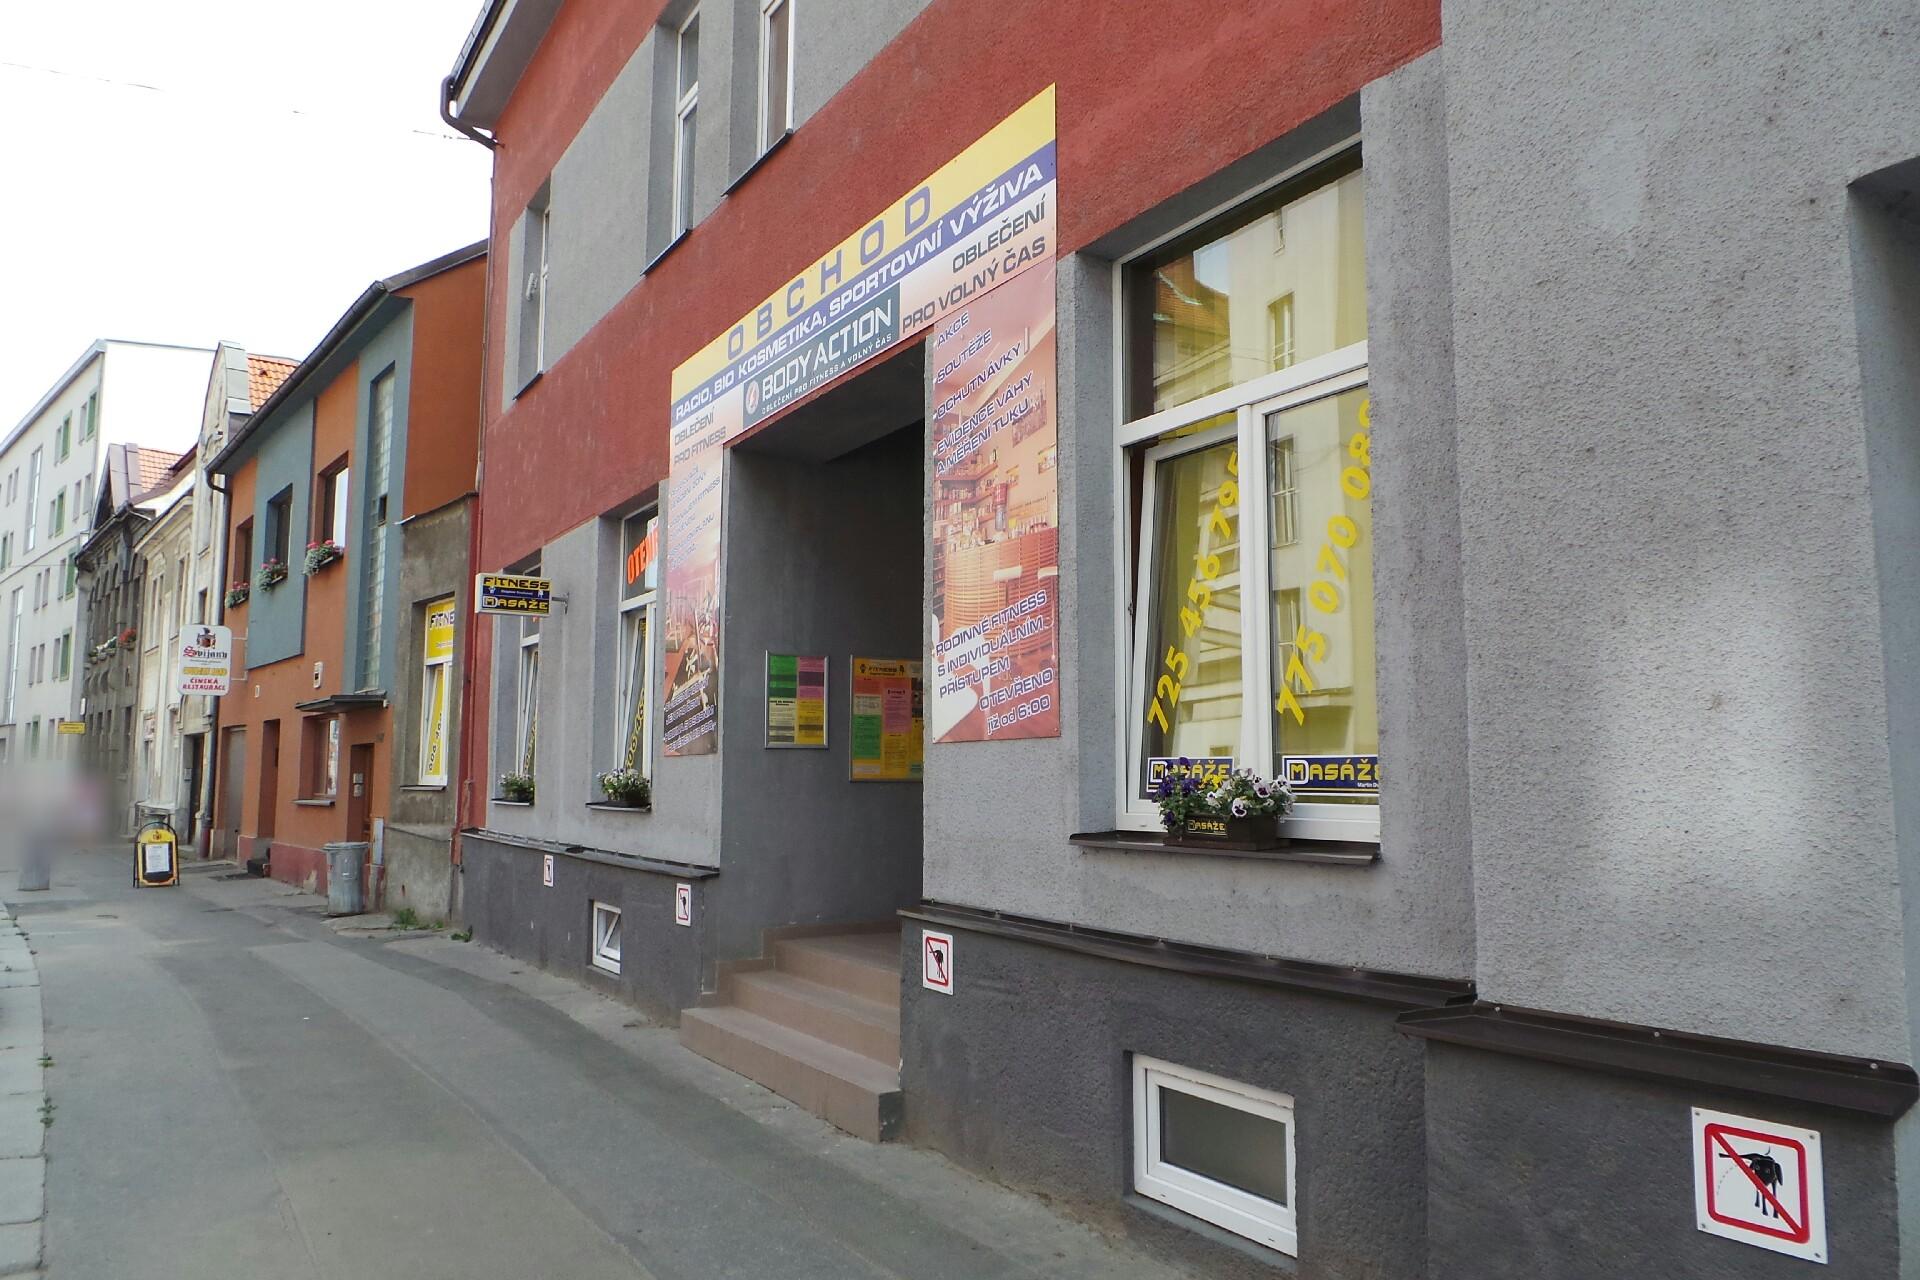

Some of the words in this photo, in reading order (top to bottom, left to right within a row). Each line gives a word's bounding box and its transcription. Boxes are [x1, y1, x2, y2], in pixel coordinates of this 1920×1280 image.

[952, 194, 1046, 273] OBLEČENÍ
[675, 385, 713, 422] RACIO,
[714, 372, 735, 396] BIO
[737, 311, 826, 378] KOSMETIKA,
[829, 220, 943, 315] SPORTOVNÍ
[949, 163, 1043, 236] VÝŽIVA
[727, 185, 931, 362] OBCHOD
[902, 302, 935, 333] PRO
[941, 257, 999, 311] VOLNÝ
[1003, 236, 1045, 275] ČAS
[937, 312, 969, 348] AKCE
[937, 329, 992, 382] SOUTĚŽE
[762, 350, 817, 402] BODY
[794, 383, 808, 397] PRO
[808, 364, 839, 390] FITNESS
[847, 343, 873, 363] VOLNÝ
[875, 333, 891, 350] ČAS
[936, 342, 1021, 418] OCHUTNÁVKY
[674, 406, 715, 447] OBLEČENÍ
[936, 460, 946, 475] A
[944, 423, 991, 470] MĚŘENÍ
[994, 398, 1029, 432] TUKU
[937, 402, 995, 455] EVIDENCE
[997, 372, 1032, 408] VÁHY
[674, 449, 691, 465] PRO
[691, 426, 726, 457] FITNESS
[484, 576, 550, 590] FITNESS
[484, 596, 548, 610] MASÁŽE
[936, 616, 990, 656] RODINNÉ
[991, 590, 1047, 629] FITNESS
[938, 664, 946, 677] S
[947, 616, 1043, 673] INDIVIDUÁLNÍM
[1147, 646, 1189, 734] 725
[1181, 554, 1221, 639] 456
[1275, 624, 1326, 726] 775
[1308, 514, 1358, 614] 070
[939, 656, 1010, 698] PŘÍSTUPEM
[980, 670, 1053, 711] OTEVŘENO
[988, 714, 1000, 734] již
[1001, 711, 1015, 726] od
[1017, 695, 1051, 719] 6:00
[1287, 759, 1378, 785] MASÁŽ
